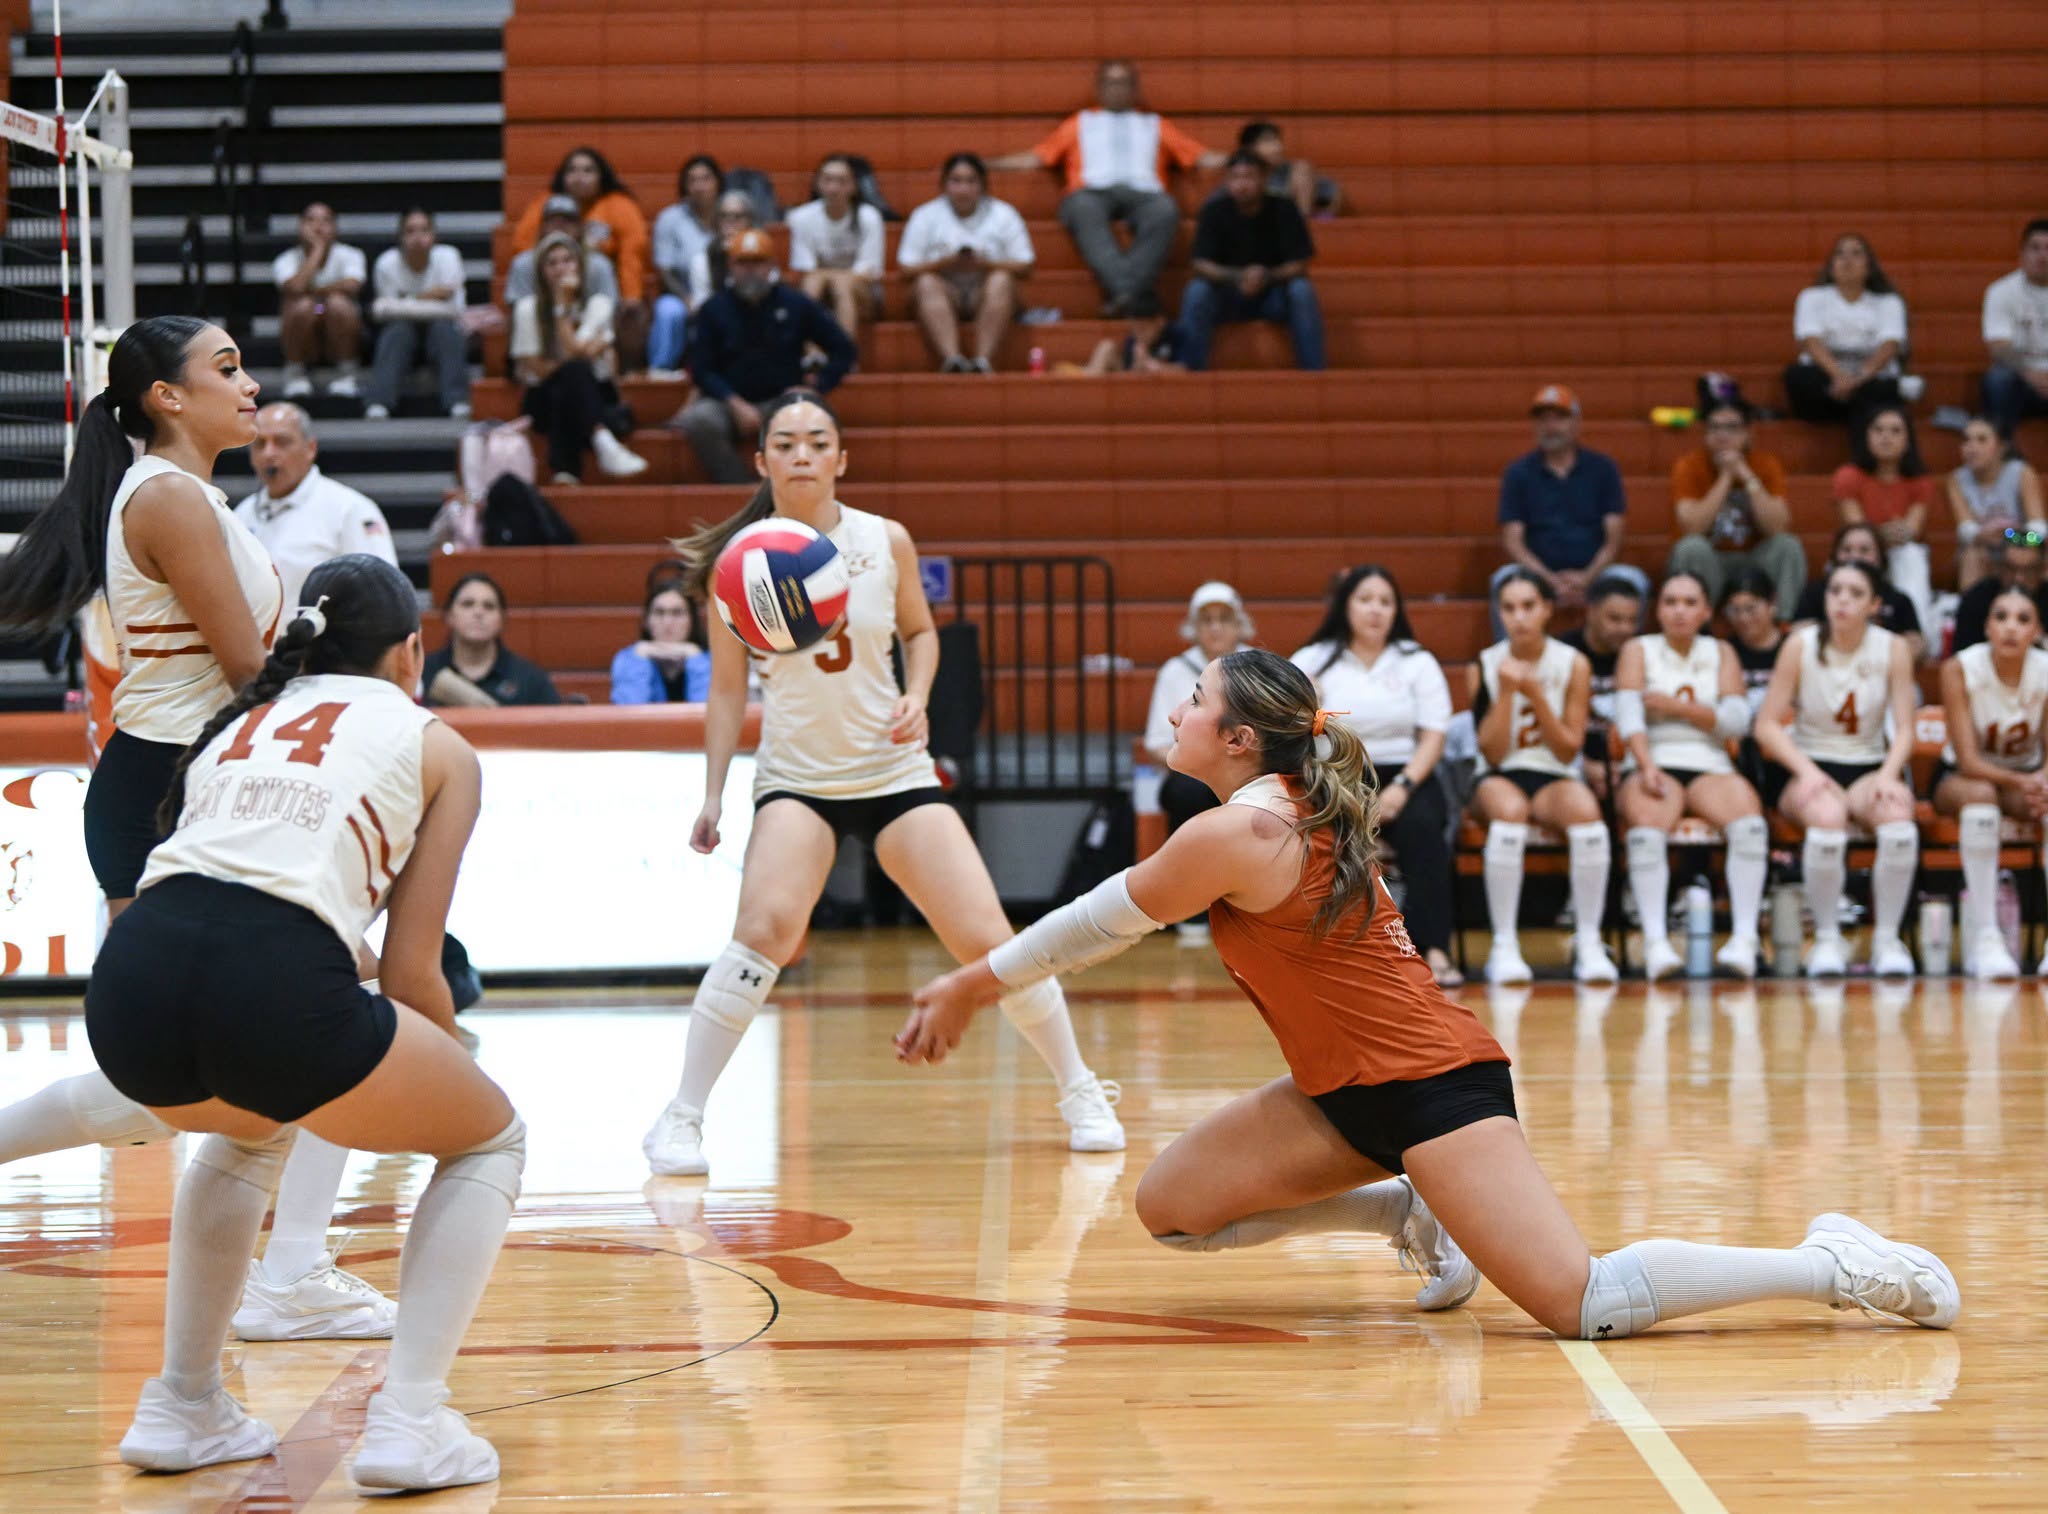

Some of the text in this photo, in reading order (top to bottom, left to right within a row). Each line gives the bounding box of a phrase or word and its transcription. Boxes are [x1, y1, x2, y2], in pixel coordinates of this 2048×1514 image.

[814, 620, 853, 674] 3
[217, 701, 351, 767] 14
[1518, 706, 1541, 748] 2
[1834, 692, 1858, 735] 4
[1985, 721, 2030, 755] 12
[231, 776, 332, 832] COYOTES
